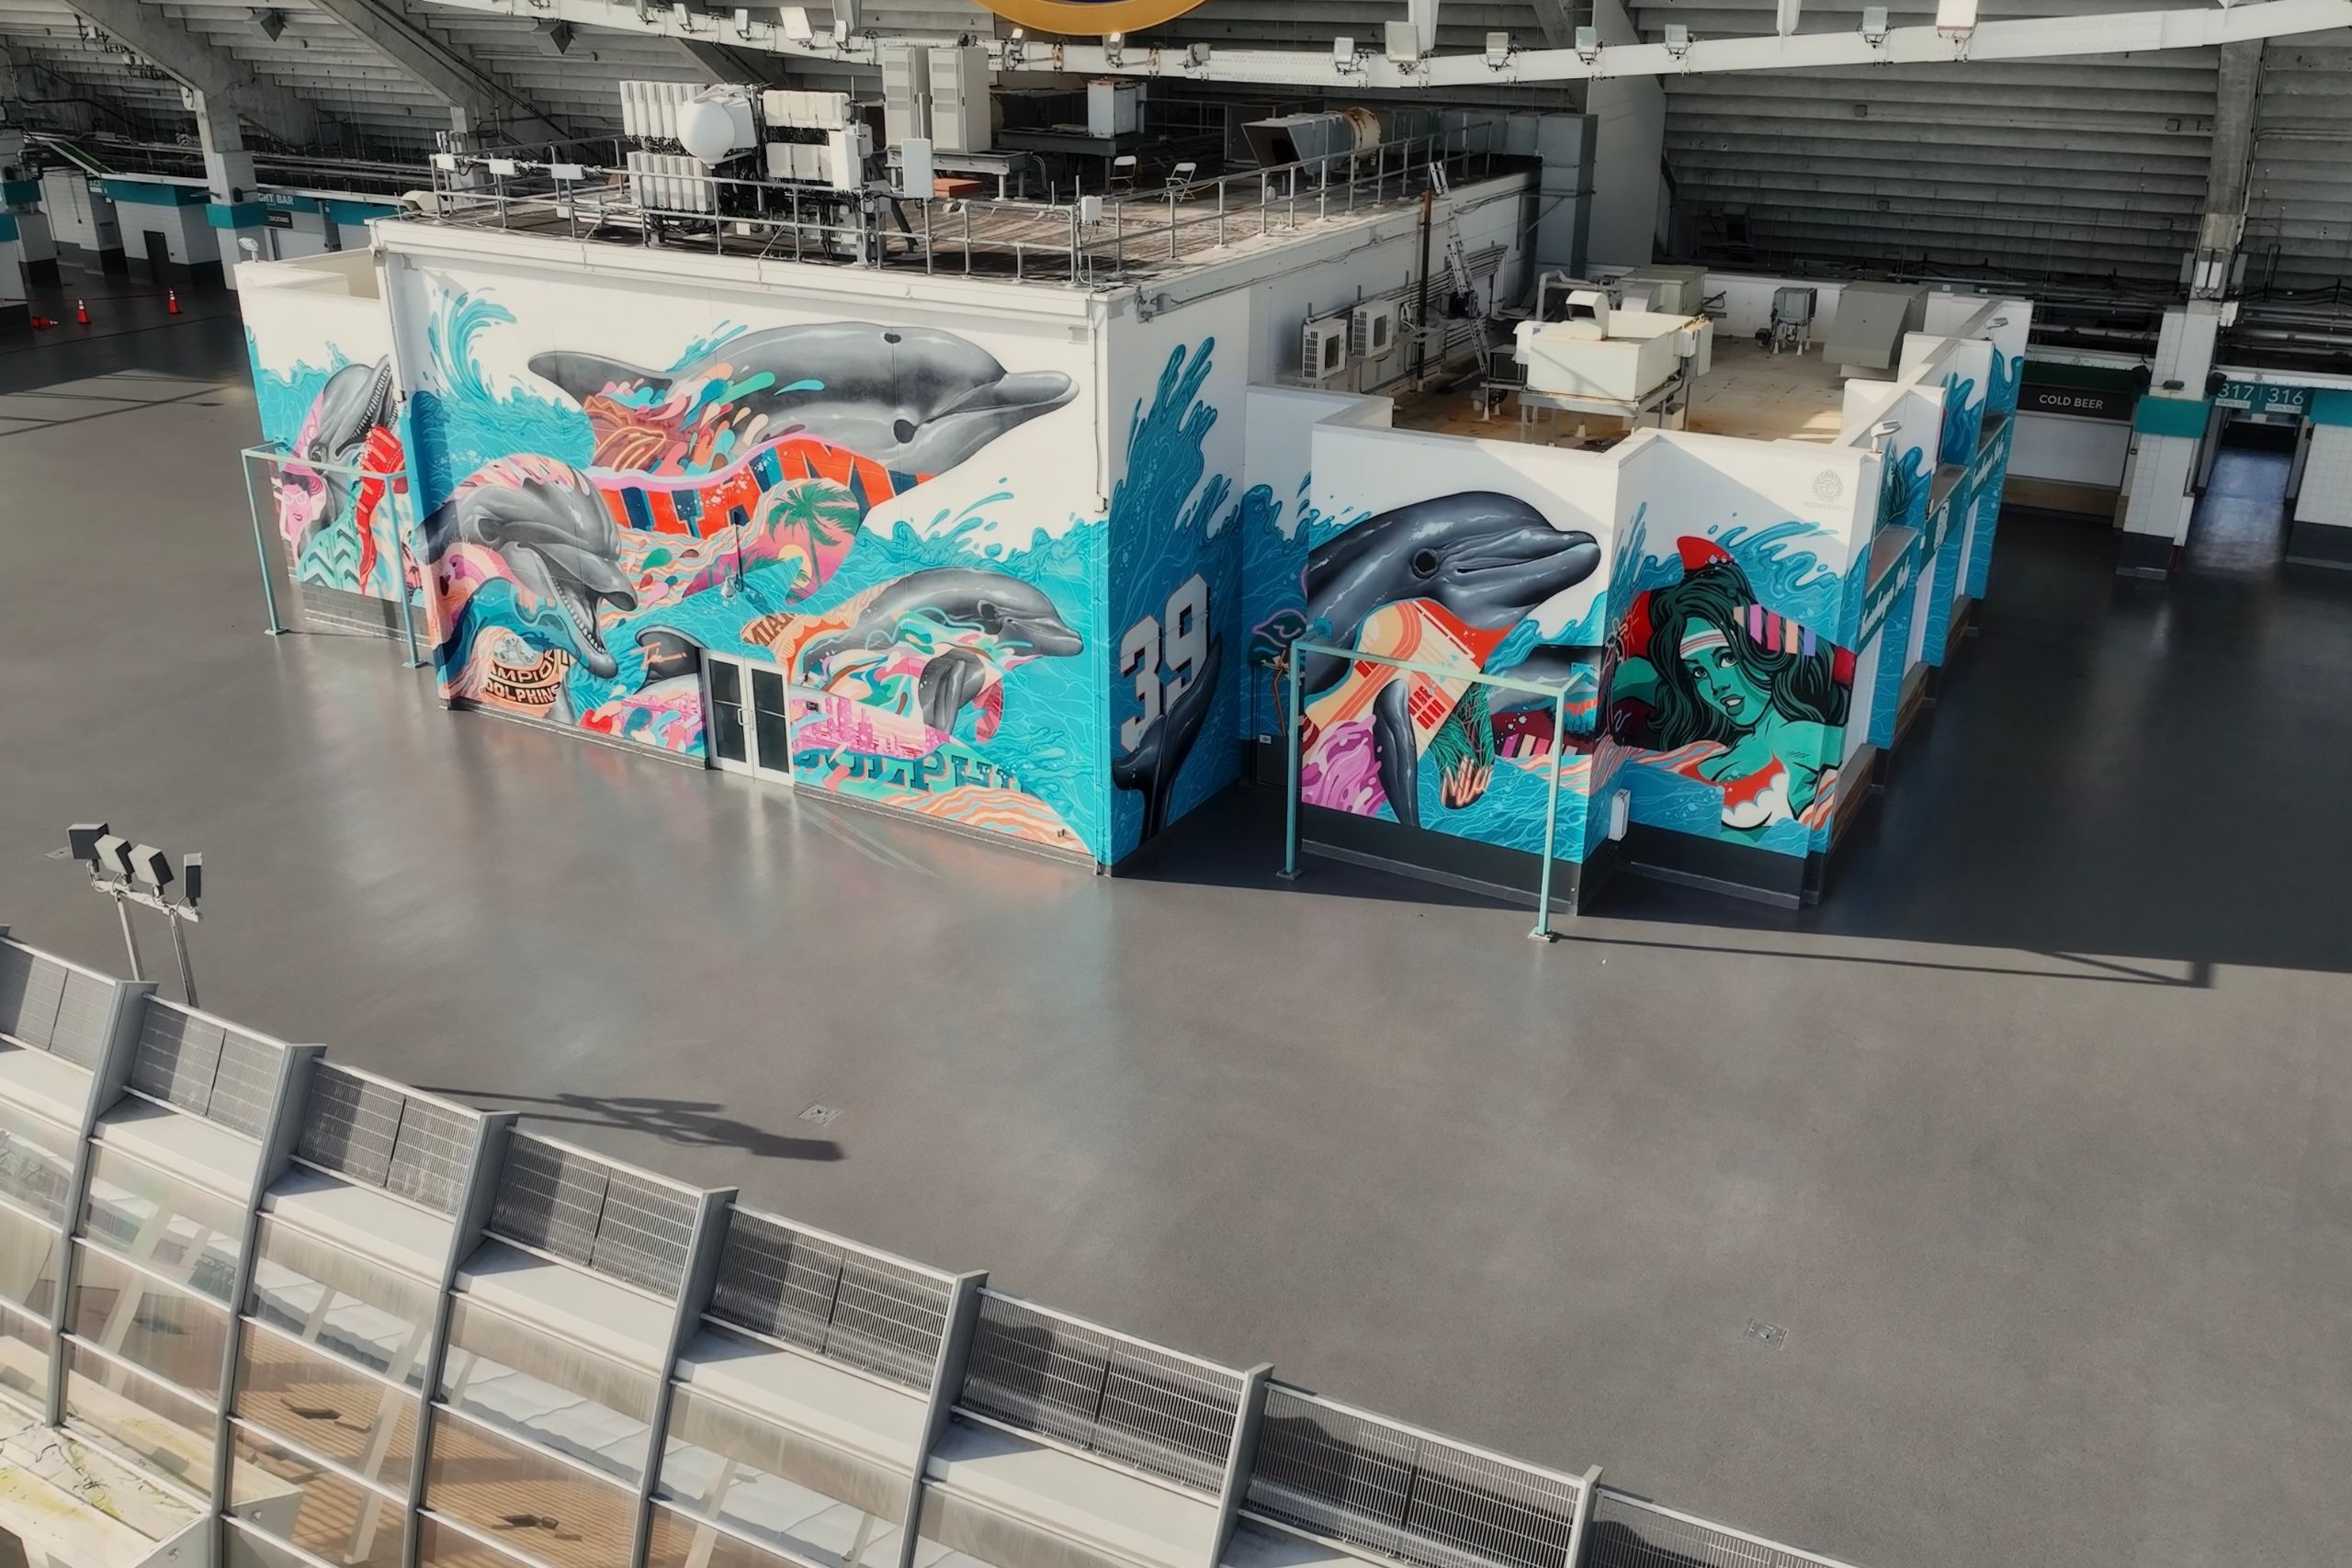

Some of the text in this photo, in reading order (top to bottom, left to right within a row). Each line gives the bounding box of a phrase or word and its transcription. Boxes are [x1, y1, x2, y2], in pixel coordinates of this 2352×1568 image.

[277, 194, 294, 206] BAR
[2218, 383, 2255, 400] 317
[2267, 388, 2304, 404] 316
[2039, 394, 2104, 410] COLD BEER
[1120, 573, 1209, 753] 39
